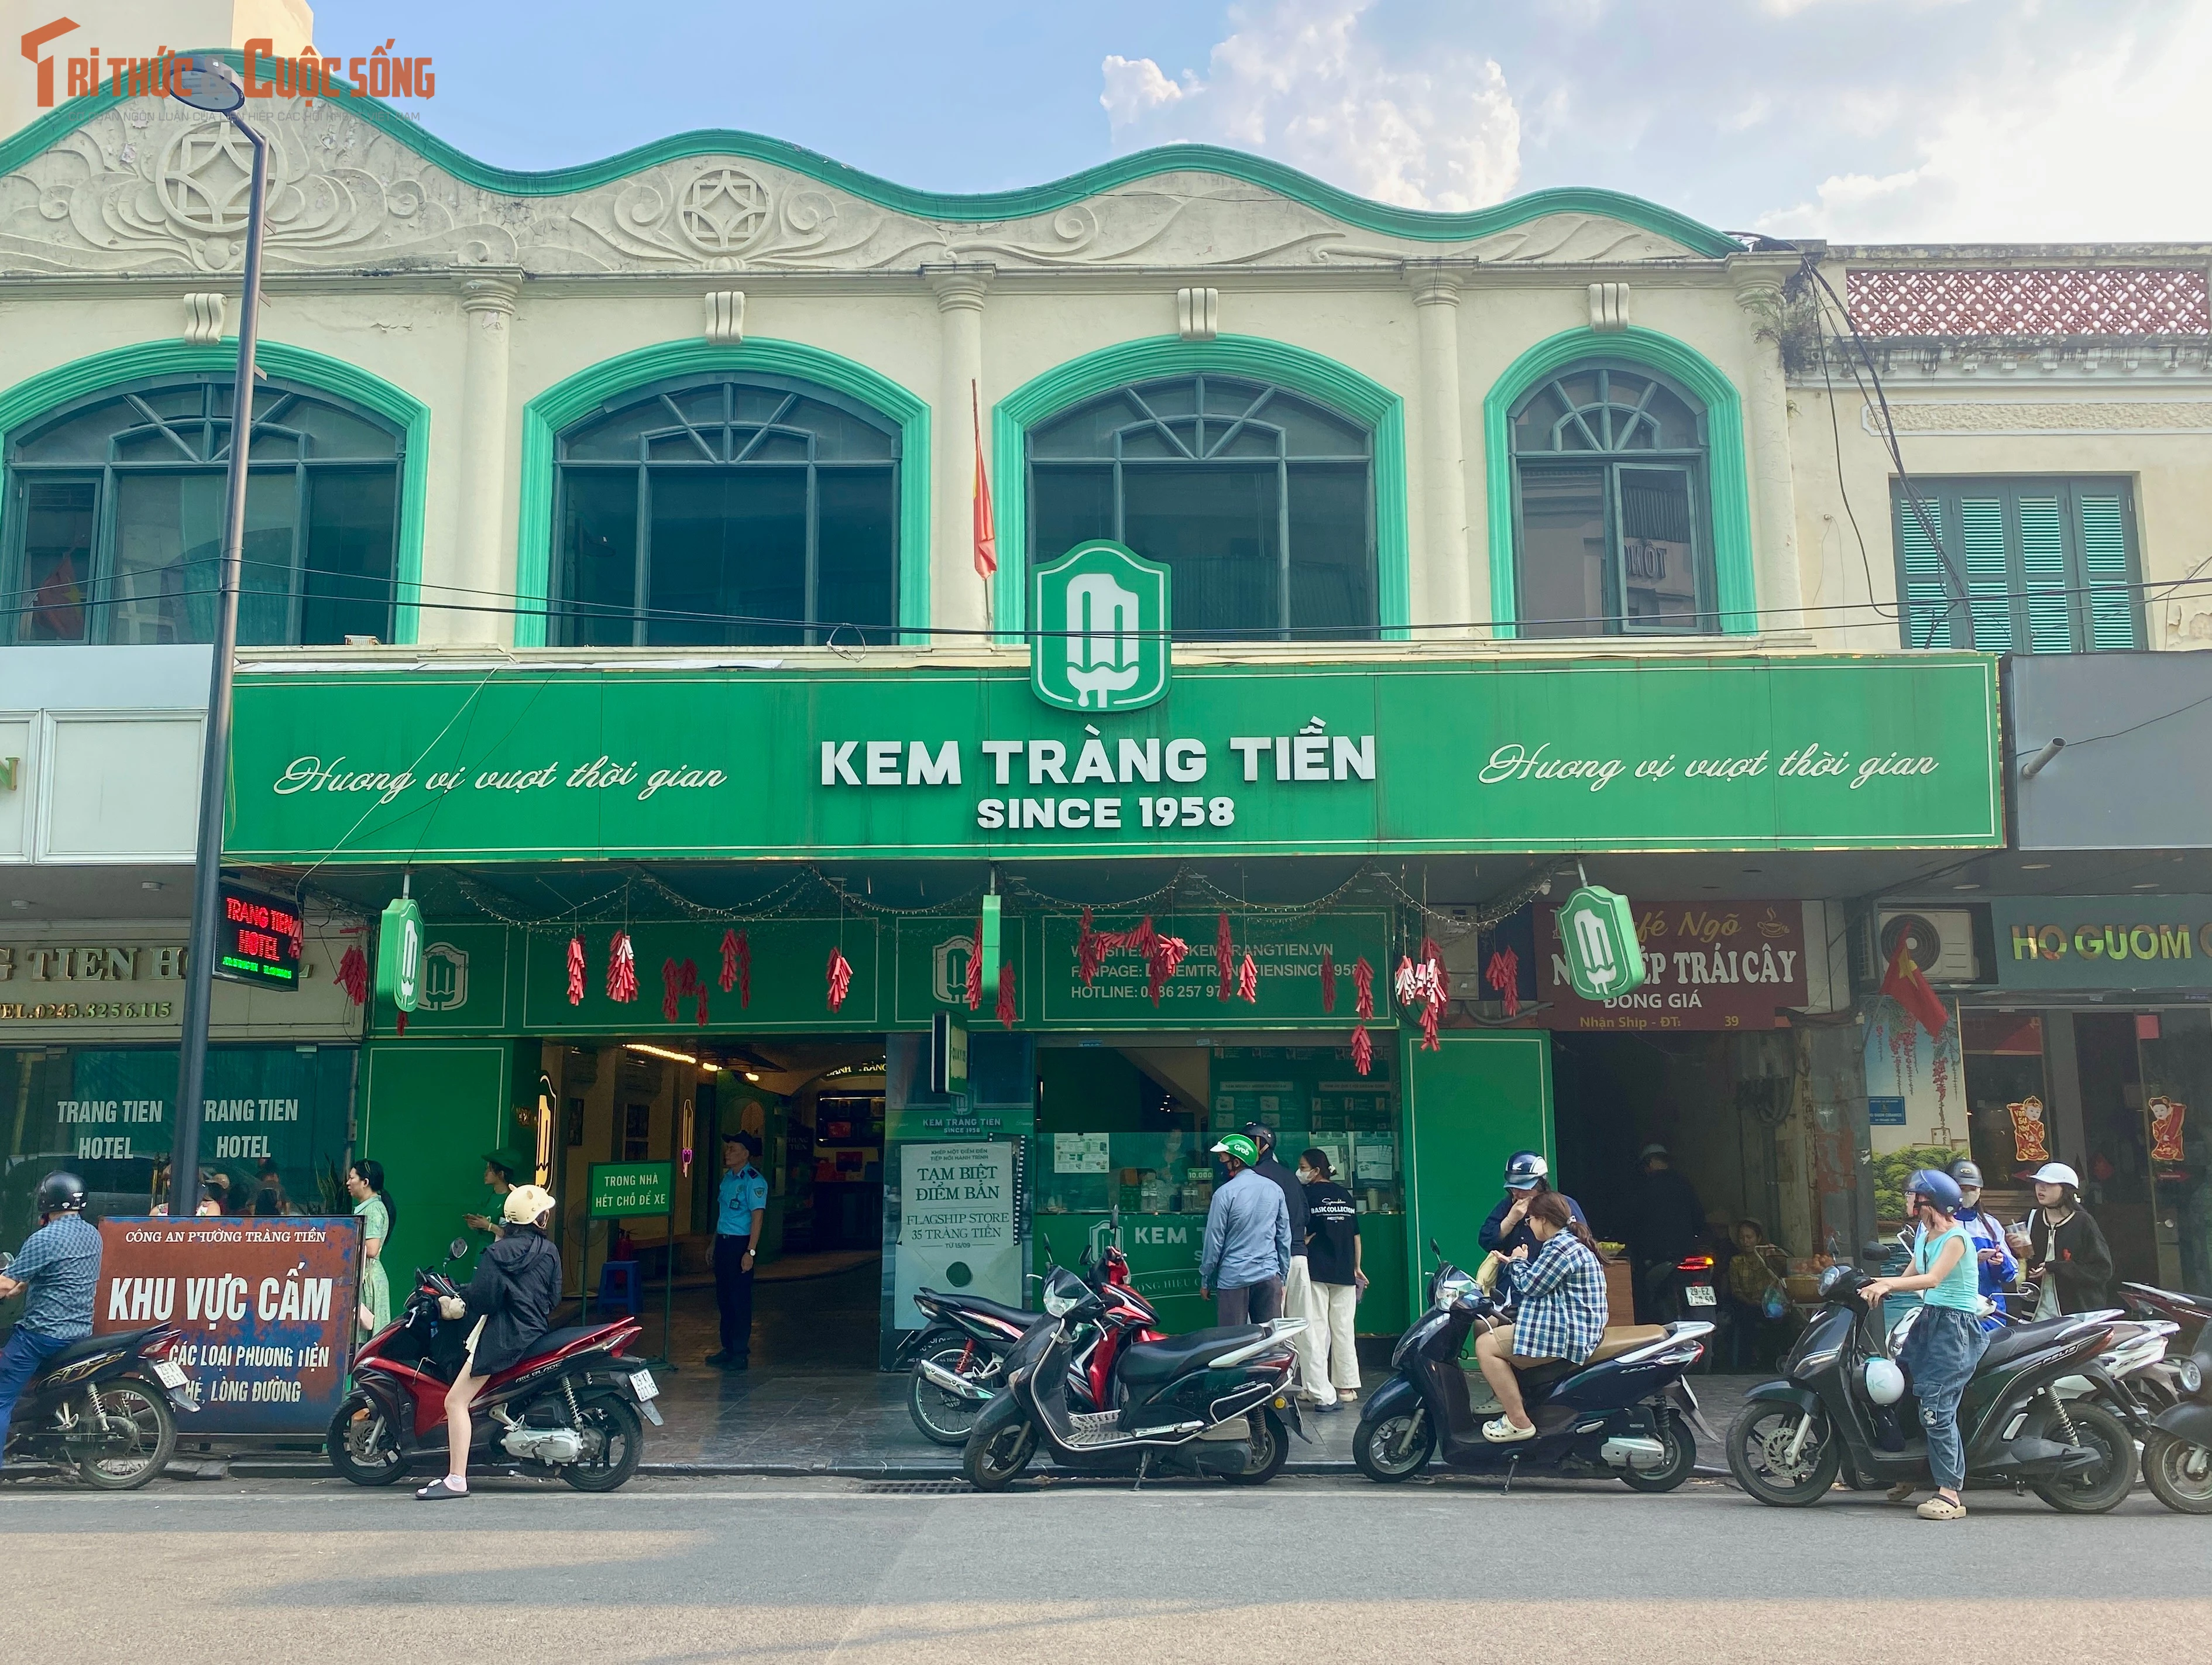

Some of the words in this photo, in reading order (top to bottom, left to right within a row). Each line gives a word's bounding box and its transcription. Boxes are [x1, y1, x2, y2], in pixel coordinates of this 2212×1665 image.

[821, 740, 962, 785] KEM
[982, 723, 1207, 785] TRÀNG
[1229, 715, 1376, 782] TIỀN
[1634, 753, 1676, 783] vị
[1684, 749, 1769, 783] vượt
[1777, 742, 1851, 777] thời
[1849, 751, 1940, 790] gian
[425, 765, 466, 795] vị
[475, 760, 560, 795] vượt
[565, 755, 638, 788] thời
[637, 764, 728, 801] gian
[977, 797, 1122, 829] SINCE
[1138, 797, 1235, 827] 1958
[226, 897, 269, 928] TRANG
[1677, 911, 1742, 943] Ngõ
[238, 929, 281, 962] HOTEL
[2074, 924, 2192, 960] GUOM
[26, 947, 140, 981] TIEN
[1071, 964, 1143, 978] FNPAGE:
[1673, 942, 1740, 984] TRÁI
[1742, 942, 1797, 984] CÂY
[1071, 986, 1138, 998] HOTLINE:
[1140, 986, 1174, 998] 086
[1177, 986, 1202, 998] 257
[1206, 985, 1231, 998] 97
[1668, 989, 1703, 1008] GIÁ
[1580, 1016, 1615, 1030] Nhận
[1618, 1016, 1647, 1031] Ship
[1724, 1015, 1739, 1027] 39
[57, 1101, 117, 1123] TRANG
[122, 1100, 163, 1122] TIEN
[203, 1099, 254, 1122] RANG
[258, 1098, 298, 1121] TIEN
[923, 1118, 943, 1127] KEM
[78, 1137, 134, 1159] HOTEL
[216, 1135, 272, 1158] HOTEL
[1234, 1144, 1250, 1156] Grab
[604, 1175, 636, 1187] TRONG
[640, 1172, 658, 1185] NHÀ
[917, 1166, 955, 1184] TẠM
[959, 1163, 998, 1183] BIỆT
[617, 1192, 636, 1207] CHỖ
[639, 1190, 651, 1205] ĐỂ
[654, 1193, 666, 1205] XE
[915, 1181, 960, 1201] ĐIỂM
[964, 1182, 1000, 1200] BÁN
[907, 1213, 967, 1225] FLAGSHIP
[969, 1212, 1009, 1224] STORE
[1311, 1206, 1327, 1214] BASIC
[125, 1228, 162, 1242] CÔNG
[164, 1231, 185, 1242] AN
[187, 1228, 243, 1242] PHƯỜNG
[245, 1228, 291, 1242] TRÀNG
[294, 1227, 327, 1242] TIỀN
[911, 1229, 923, 1240] 35
[925, 1226, 968, 1240] TRÀNG
[971, 1223, 1002, 1238] TIỀN
[1135, 1227, 1187, 1244] KEM
[108, 1276, 176, 1321] KHU
[186, 1272, 248, 1330] VỰC
[257, 1261, 333, 1321] CẤM
[169, 1340, 197, 1367] CÁC
[200, 1345, 232, 1372] LOẠI
[210, 1375, 249, 1402] LÒNG
[251, 1375, 302, 1402] ĐƯỜNG
